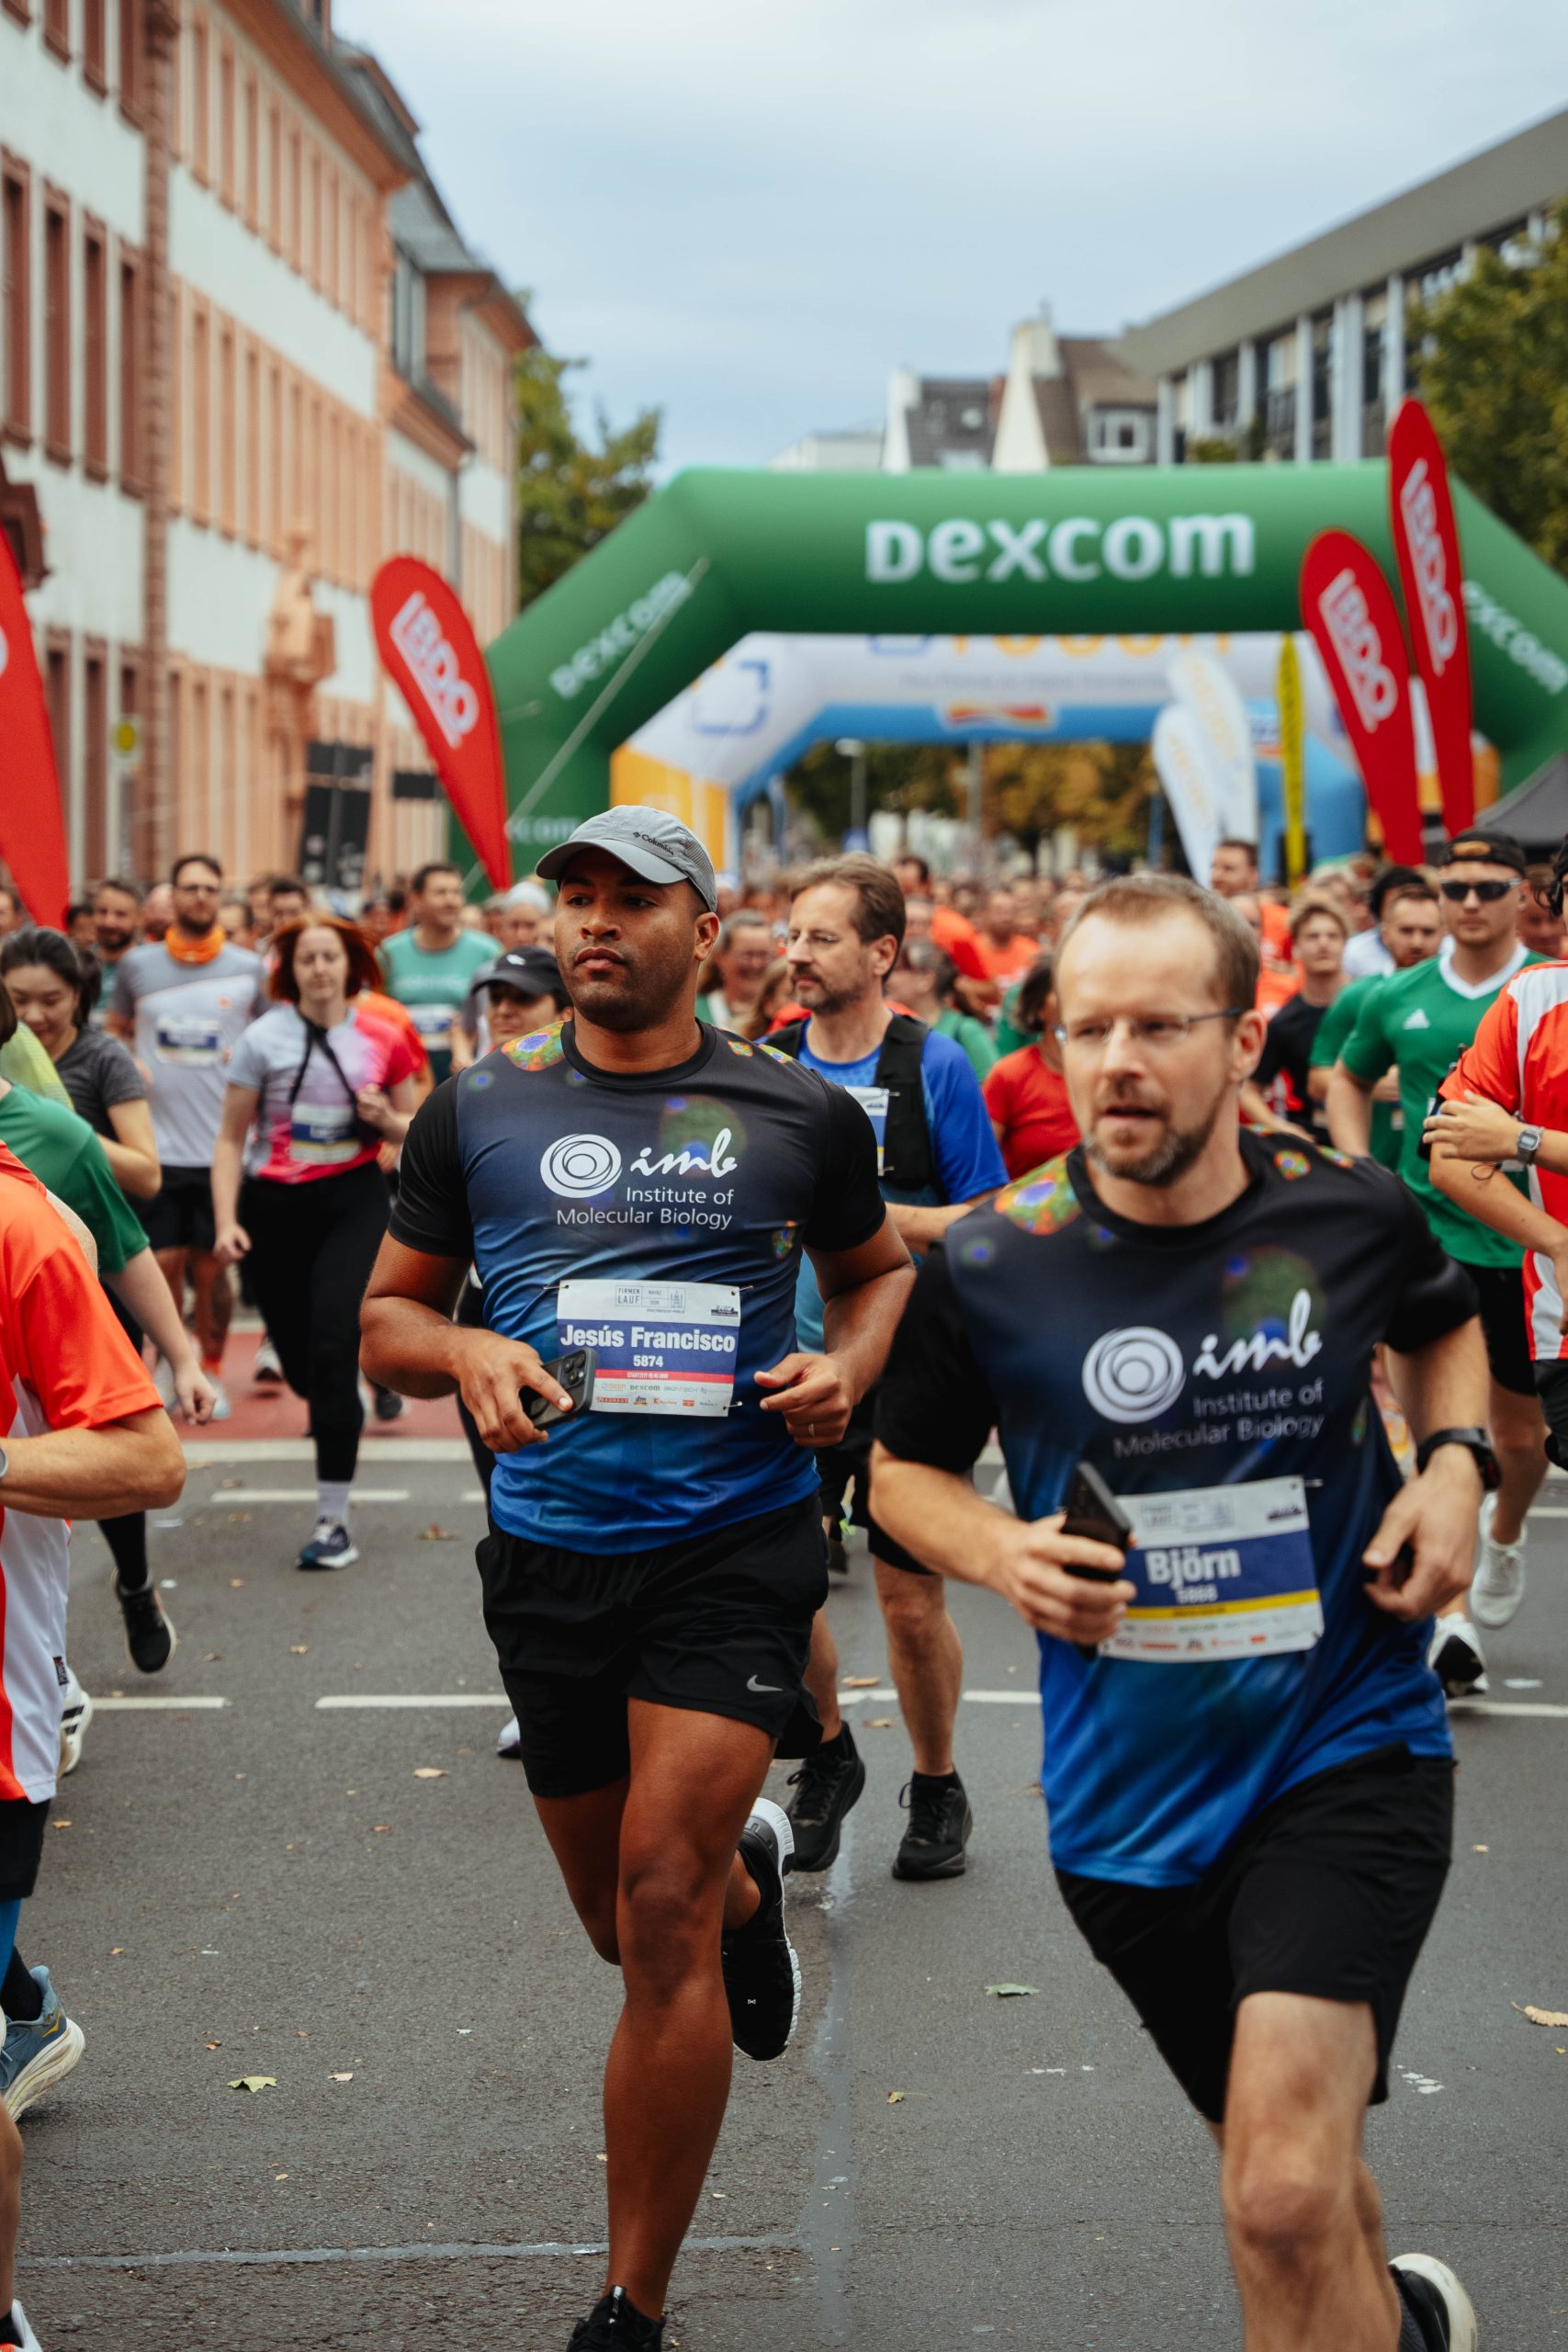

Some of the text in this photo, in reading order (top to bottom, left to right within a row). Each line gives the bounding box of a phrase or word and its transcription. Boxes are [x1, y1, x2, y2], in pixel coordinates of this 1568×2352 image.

[403, 605, 480, 738] BDO
[1328, 582, 1398, 723] BDO
[641, 833, 675, 856] Columbia
[630, 1127, 738, 1179] imb
[626, 1186, 735, 1205] Institute of
[557, 1206, 733, 1231] Molecular Biology
[617, 1295, 640, 1305] LAUF
[560, 1324, 736, 1353] Jesús Francisco
[1193, 1288, 1323, 1380] imb
[633, 1354, 665, 1368] 5874
[1193, 1376, 1324, 1418] Institute of
[1113, 1414, 1325, 1458] Molecular Biology
[1145, 1545, 1242, 1591] Björn
